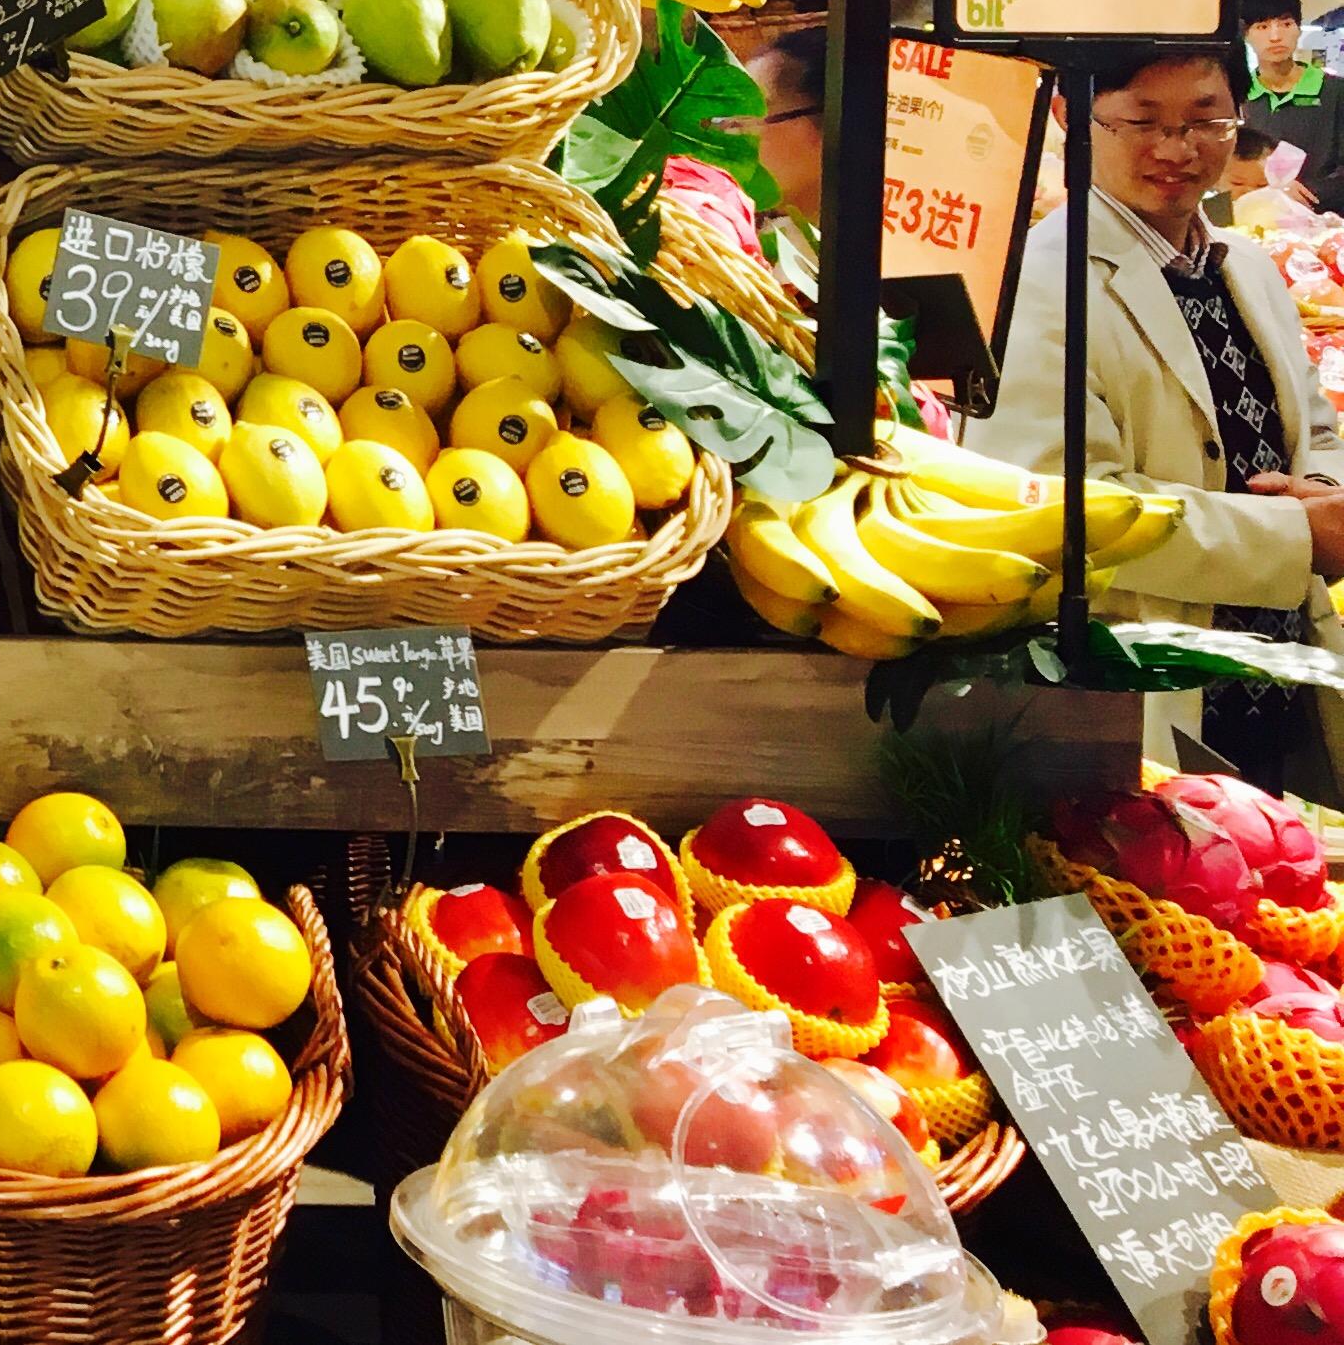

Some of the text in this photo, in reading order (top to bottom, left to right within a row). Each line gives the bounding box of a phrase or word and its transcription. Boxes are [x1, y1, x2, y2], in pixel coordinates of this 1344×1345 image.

[892, 39, 956, 79] SALE
[884, 177, 982, 250] 买3送1
[60, 216, 213, 283] 进口柠檬
